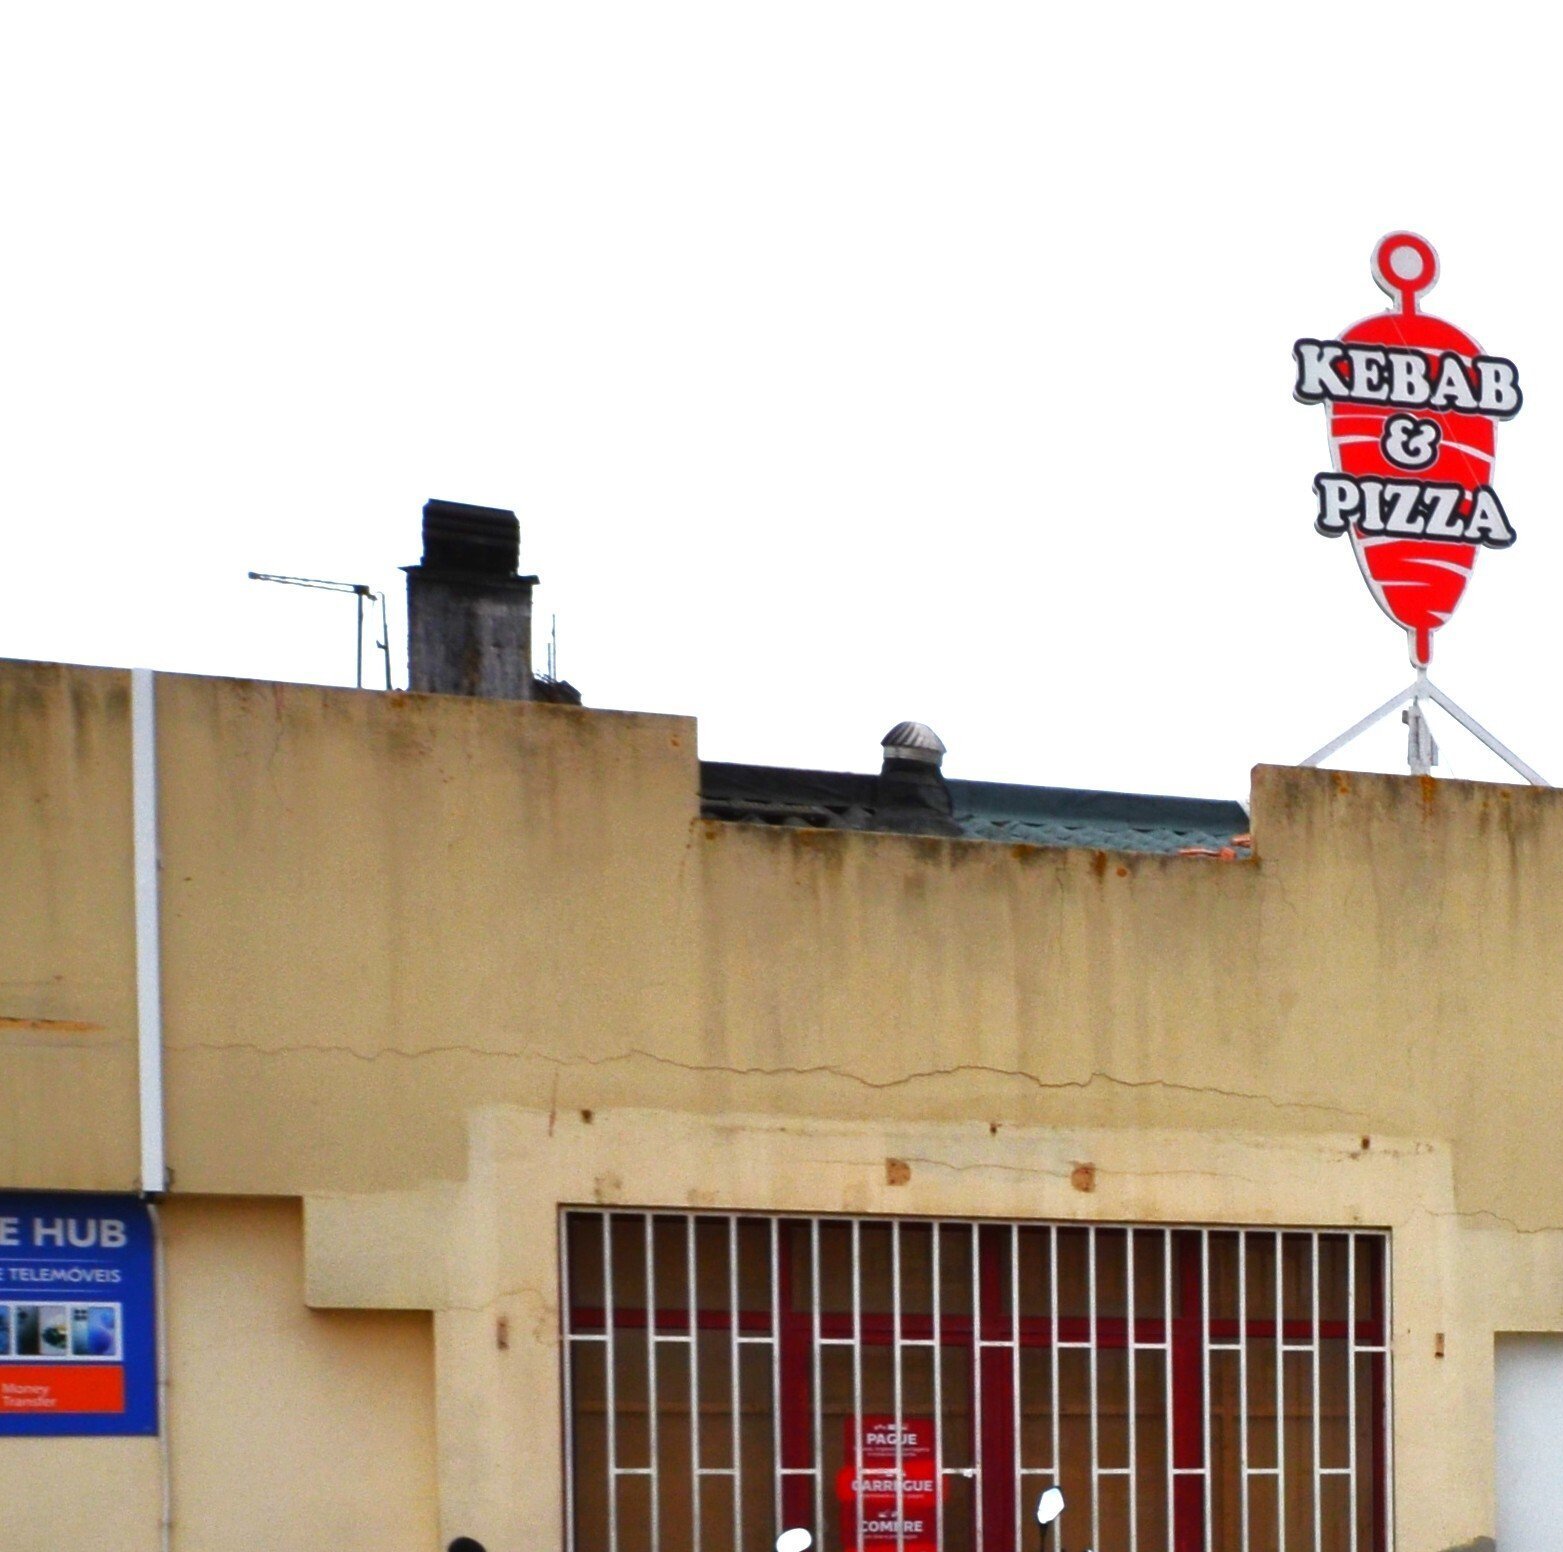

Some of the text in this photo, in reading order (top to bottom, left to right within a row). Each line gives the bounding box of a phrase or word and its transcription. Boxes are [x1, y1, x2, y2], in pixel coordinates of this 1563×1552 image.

[1294, 339, 1522, 415] KEBAB
[1384, 415, 1440, 470] &
[1316, 473, 1515, 547] PIZZA
[33, 1218, 128, 1249] HUB
[9, 1265, 122, 1284] TELEMÓVEIS
[2, 1383, 50, 1398] Money
[2, 1396, 58, 1408] Transfer
[866, 1433, 918, 1446] PAGUE
